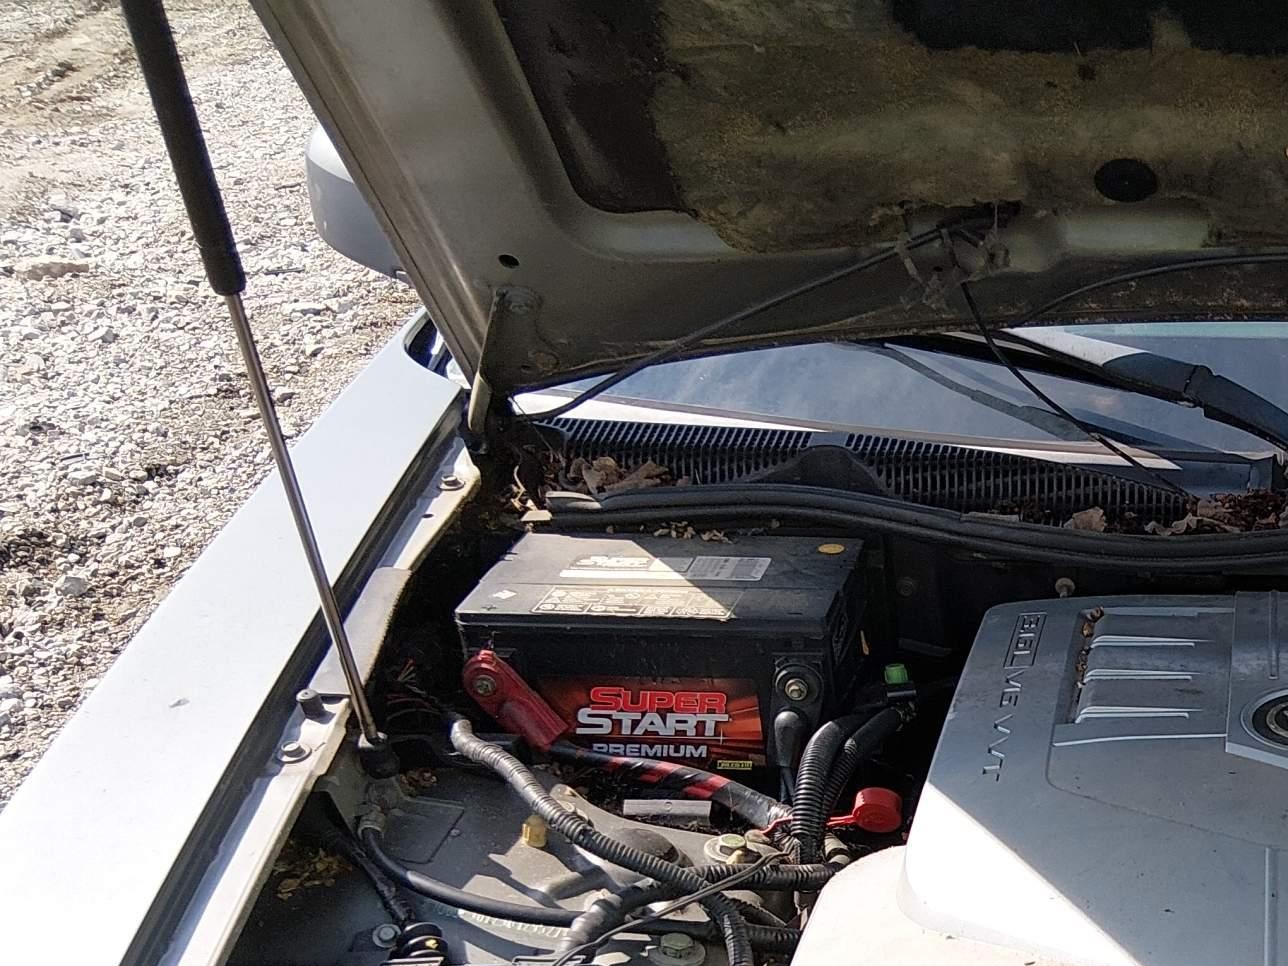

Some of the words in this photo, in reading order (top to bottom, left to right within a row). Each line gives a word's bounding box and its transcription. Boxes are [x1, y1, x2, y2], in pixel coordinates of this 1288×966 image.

[589, 687, 728, 713] SUPER
[999, 670, 1025, 708] V6
[576, 707, 731, 737] START
[592, 743, 708, 759] PREMIUM
[982, 713, 1014, 783] VVT
